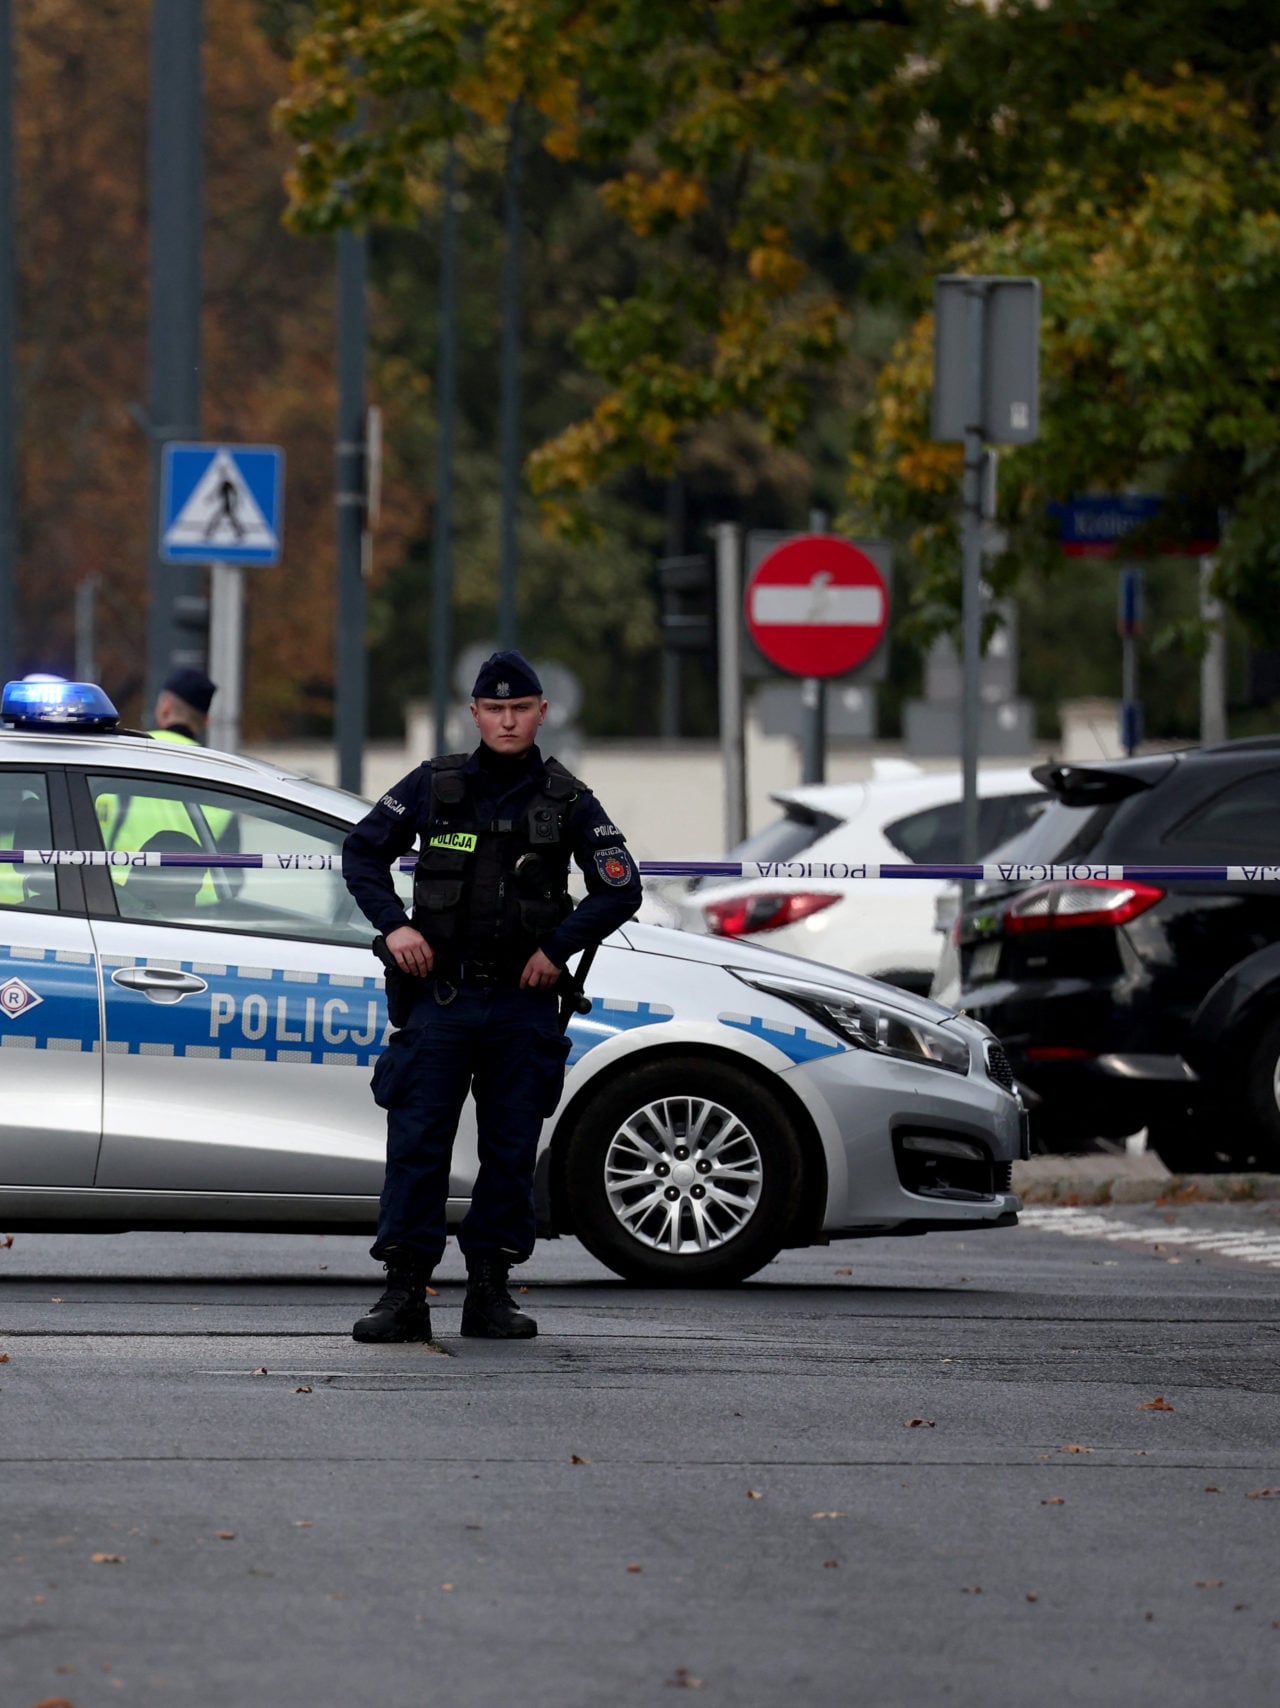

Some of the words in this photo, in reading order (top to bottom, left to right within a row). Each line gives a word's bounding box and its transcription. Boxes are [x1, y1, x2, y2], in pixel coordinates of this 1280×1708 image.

[39, 851, 147, 866] POLICJA
[756, 862, 867, 878] POLICJA
[998, 865, 1109, 881] POLICJA
[8, 992, 19, 1004] R
